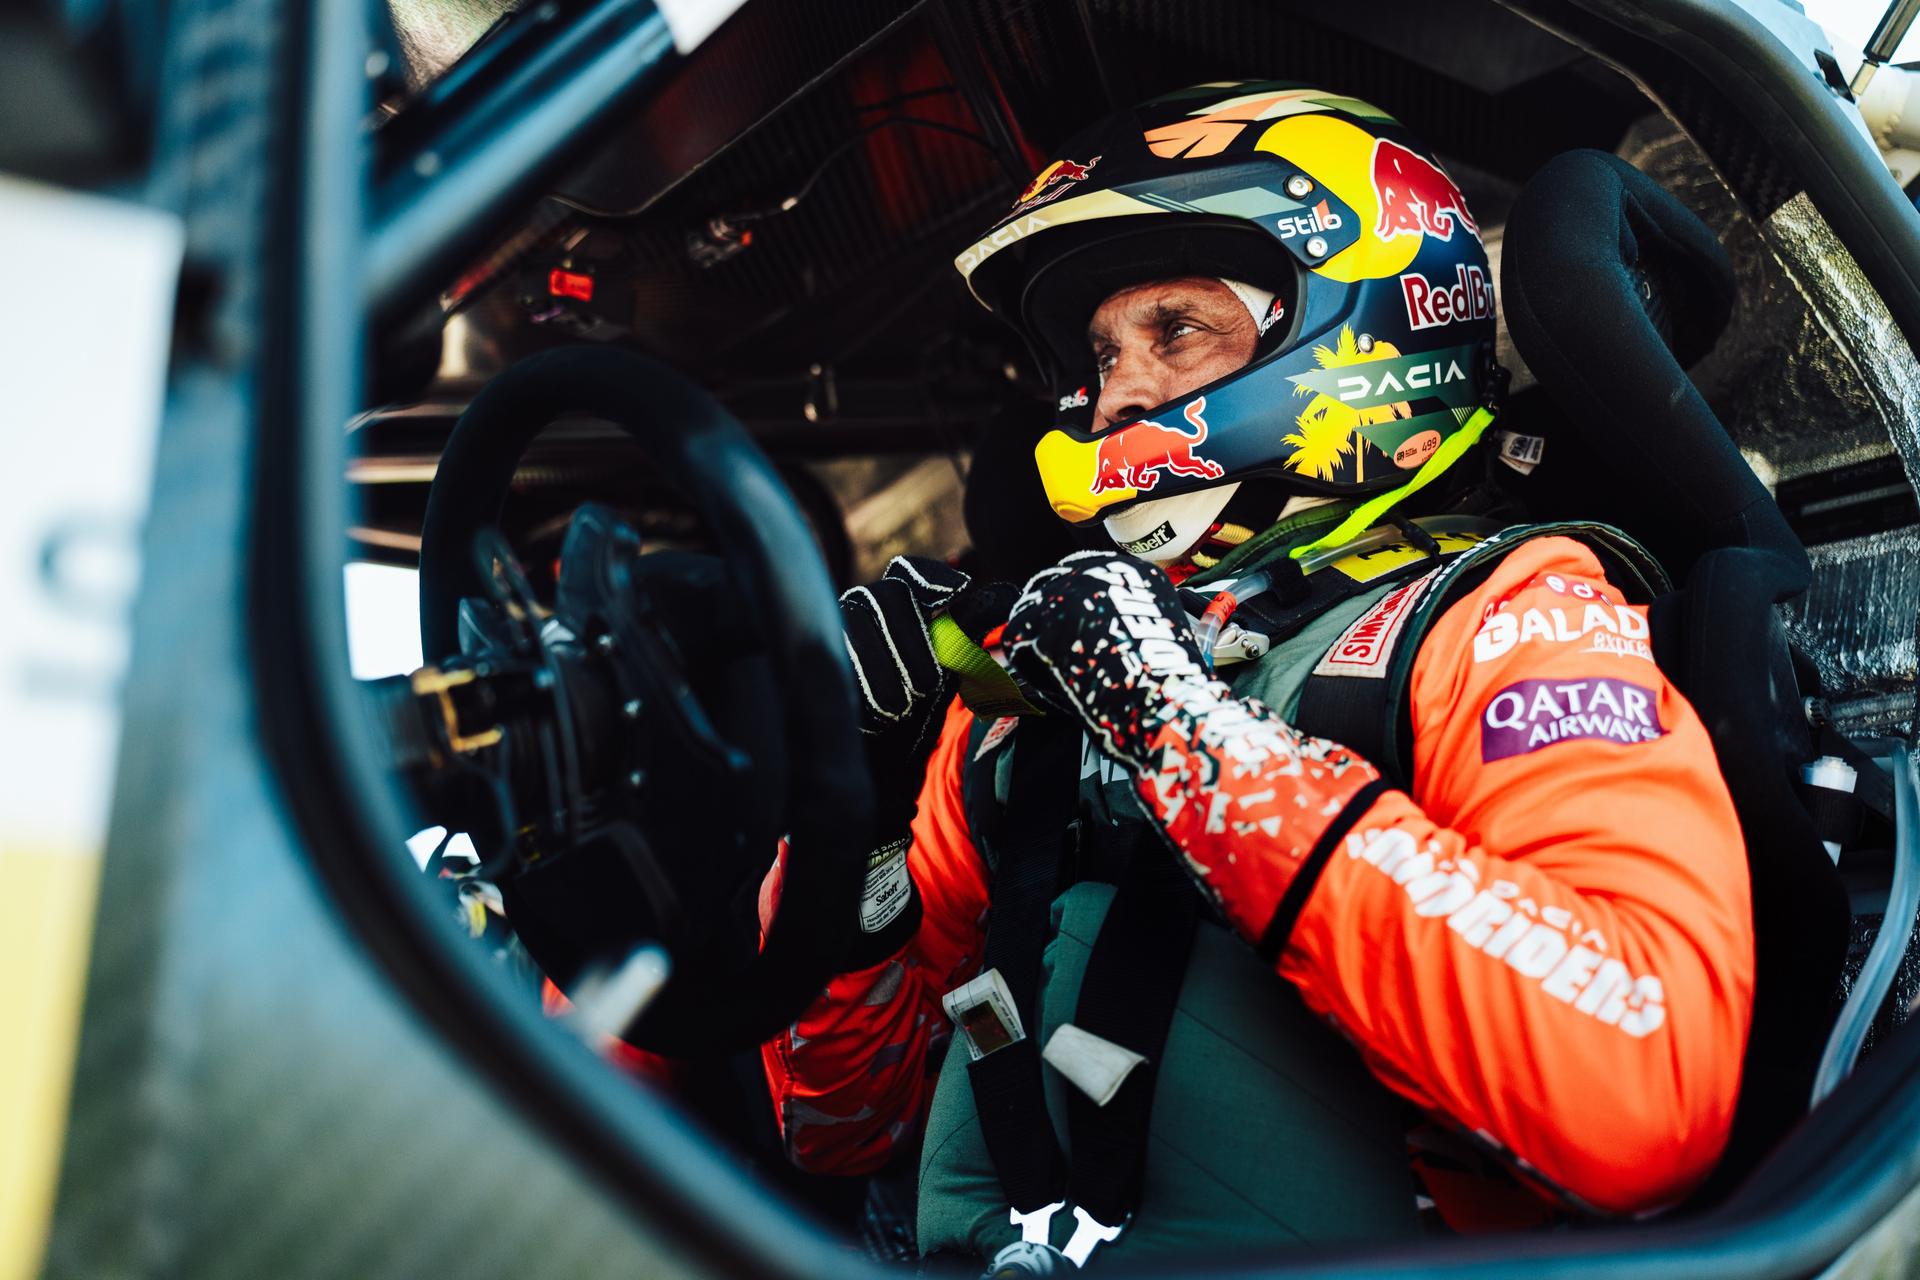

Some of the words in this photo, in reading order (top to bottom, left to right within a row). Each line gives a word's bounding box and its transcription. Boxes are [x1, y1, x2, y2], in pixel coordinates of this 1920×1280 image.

[1277, 198, 1342, 239] Stilo
[957, 214, 1050, 271] DACIA
[1467, 265, 1496, 319] Bu
[1337, 359, 1466, 401] DACIA
[1421, 436, 1438, 452] 499
[1121, 525, 1171, 554] Sabelt
[1593, 630, 1654, 663] expre
[1485, 681, 1652, 732] QATAR
[1528, 712, 1661, 747] AIRWAYS
